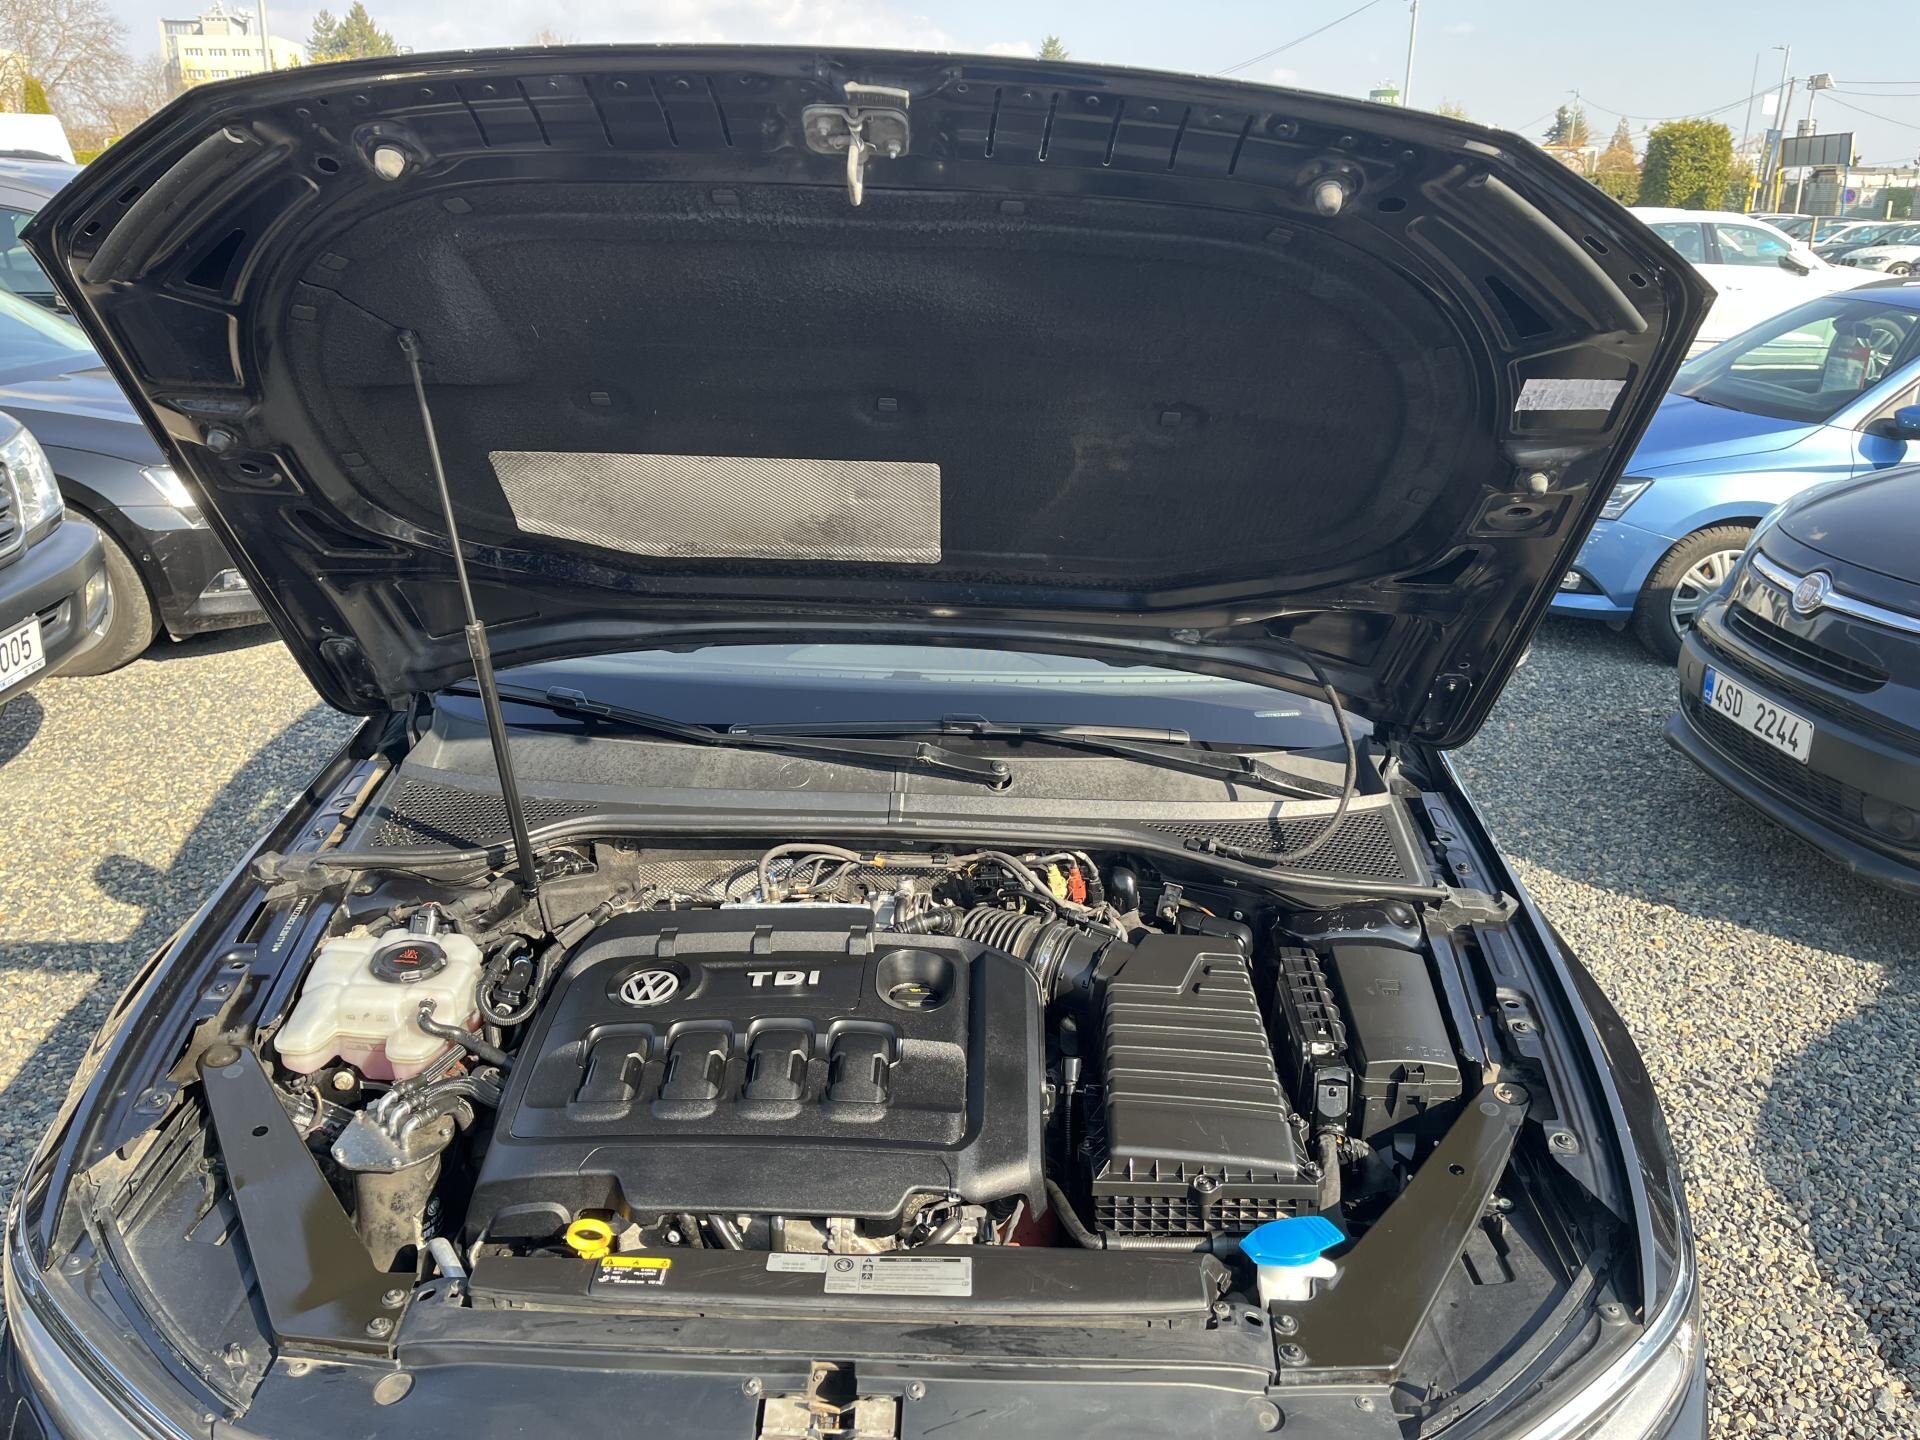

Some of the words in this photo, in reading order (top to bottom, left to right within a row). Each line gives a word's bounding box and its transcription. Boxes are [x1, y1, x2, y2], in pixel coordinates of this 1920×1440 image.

[0, 629, 31, 672] 005
[1715, 680, 1743, 717] 4SD
[1754, 703, 1799, 752] 2244
[747, 970, 820, 986] TDI
